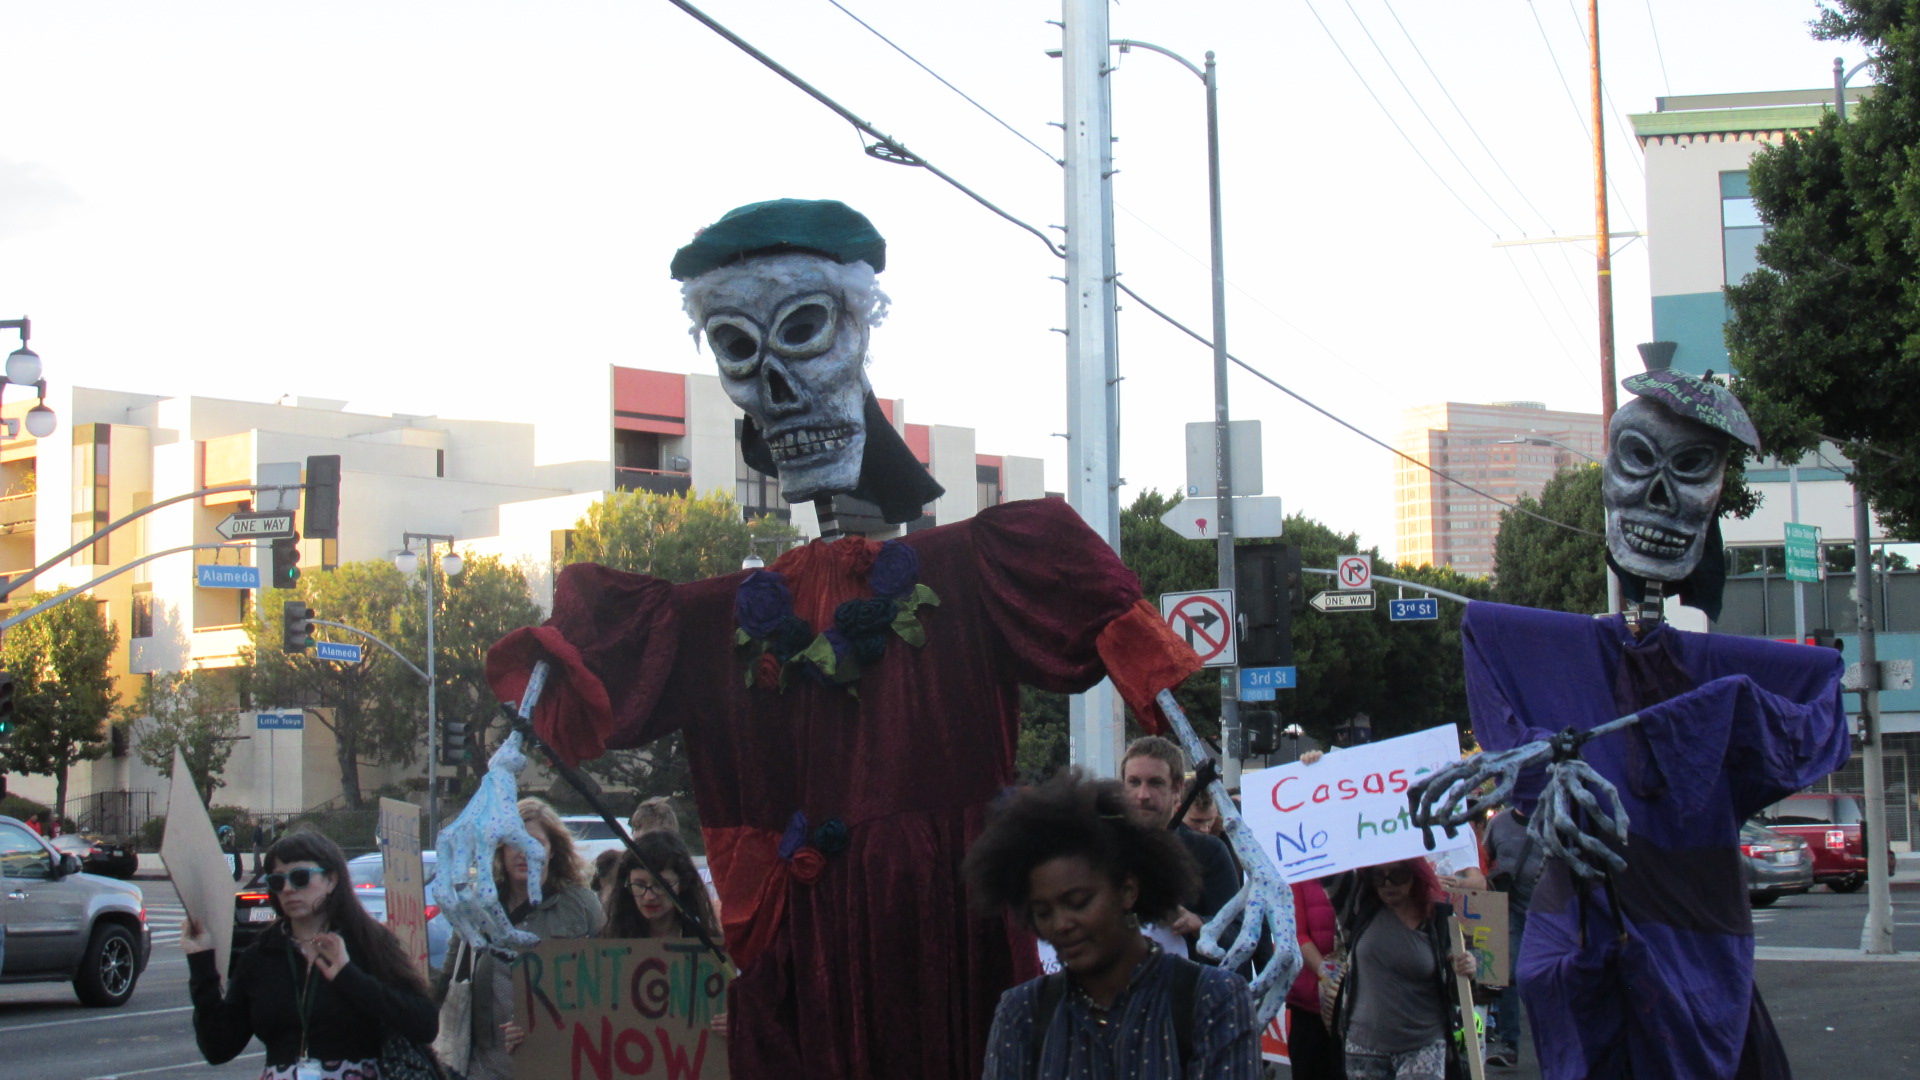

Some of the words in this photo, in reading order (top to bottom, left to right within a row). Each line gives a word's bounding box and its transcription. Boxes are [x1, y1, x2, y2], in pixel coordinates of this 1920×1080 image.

[232, 520, 257, 533] ONE
[263, 518, 286, 530] WAY
[203, 569, 256, 583] Alameda
[1325, 596, 1345, 606] ONE
[1349, 596, 1368, 605] WAY
[1396, 603, 1416, 617] 3rd
[1419, 603, 1431, 615] St
[321, 646, 357, 658] Alameda
[1250, 671, 1271, 685] 3rd
[1275, 670, 1287, 684] St
[260, 717, 279, 725] Little
[282, 718, 301, 726] Tokyo
[1271, 769, 1409, 813] Casas
[1275, 821, 1329, 861] No
[511, 947, 633, 1034] RENT
[571, 1016, 709, 1080] NOW
